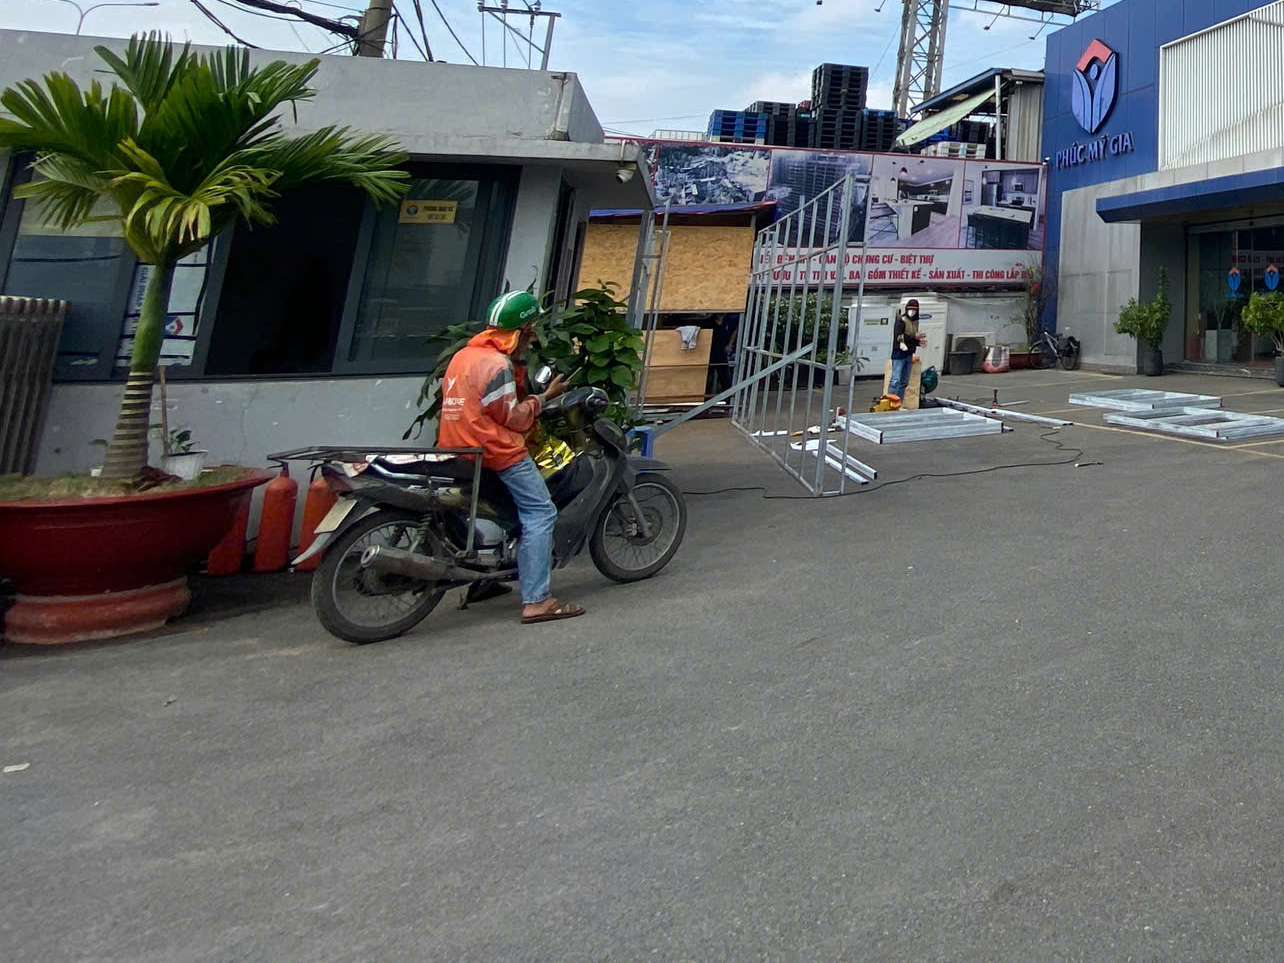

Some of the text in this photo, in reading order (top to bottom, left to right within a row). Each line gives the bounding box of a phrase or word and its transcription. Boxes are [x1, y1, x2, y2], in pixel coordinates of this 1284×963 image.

[1056, 141, 1086, 168] PHÚC
[1110, 132, 1135, 155] GIA
[900, 253, 917, 266] BIỆT
[928, 268, 945, 279] SẢN
[946, 268, 966, 279] XUẤT
